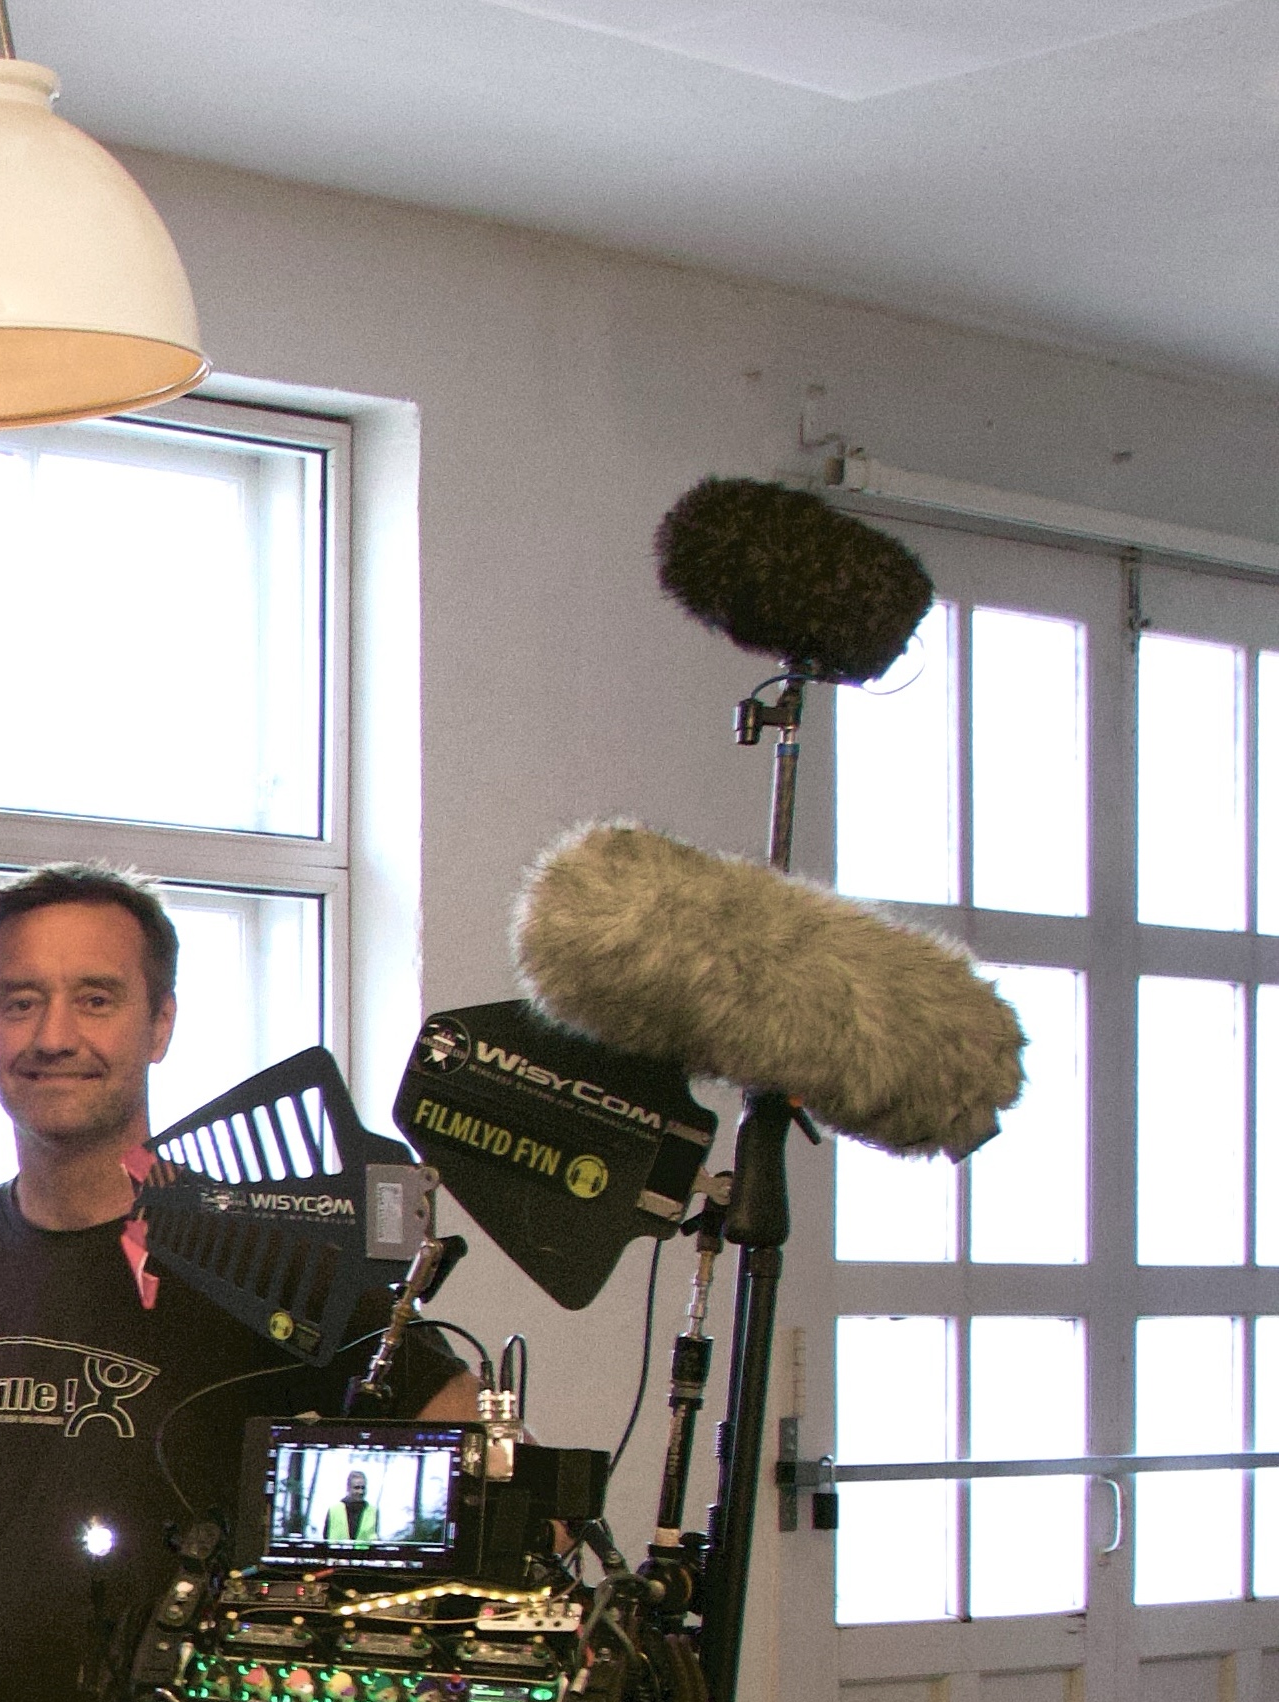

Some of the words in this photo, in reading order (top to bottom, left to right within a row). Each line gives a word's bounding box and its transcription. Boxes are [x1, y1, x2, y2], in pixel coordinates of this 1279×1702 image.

[413, 1099, 513, 1156] FILMLYD
[513, 1137, 562, 1176] FYN
[249, 1192, 356, 1216] WISYCOM
